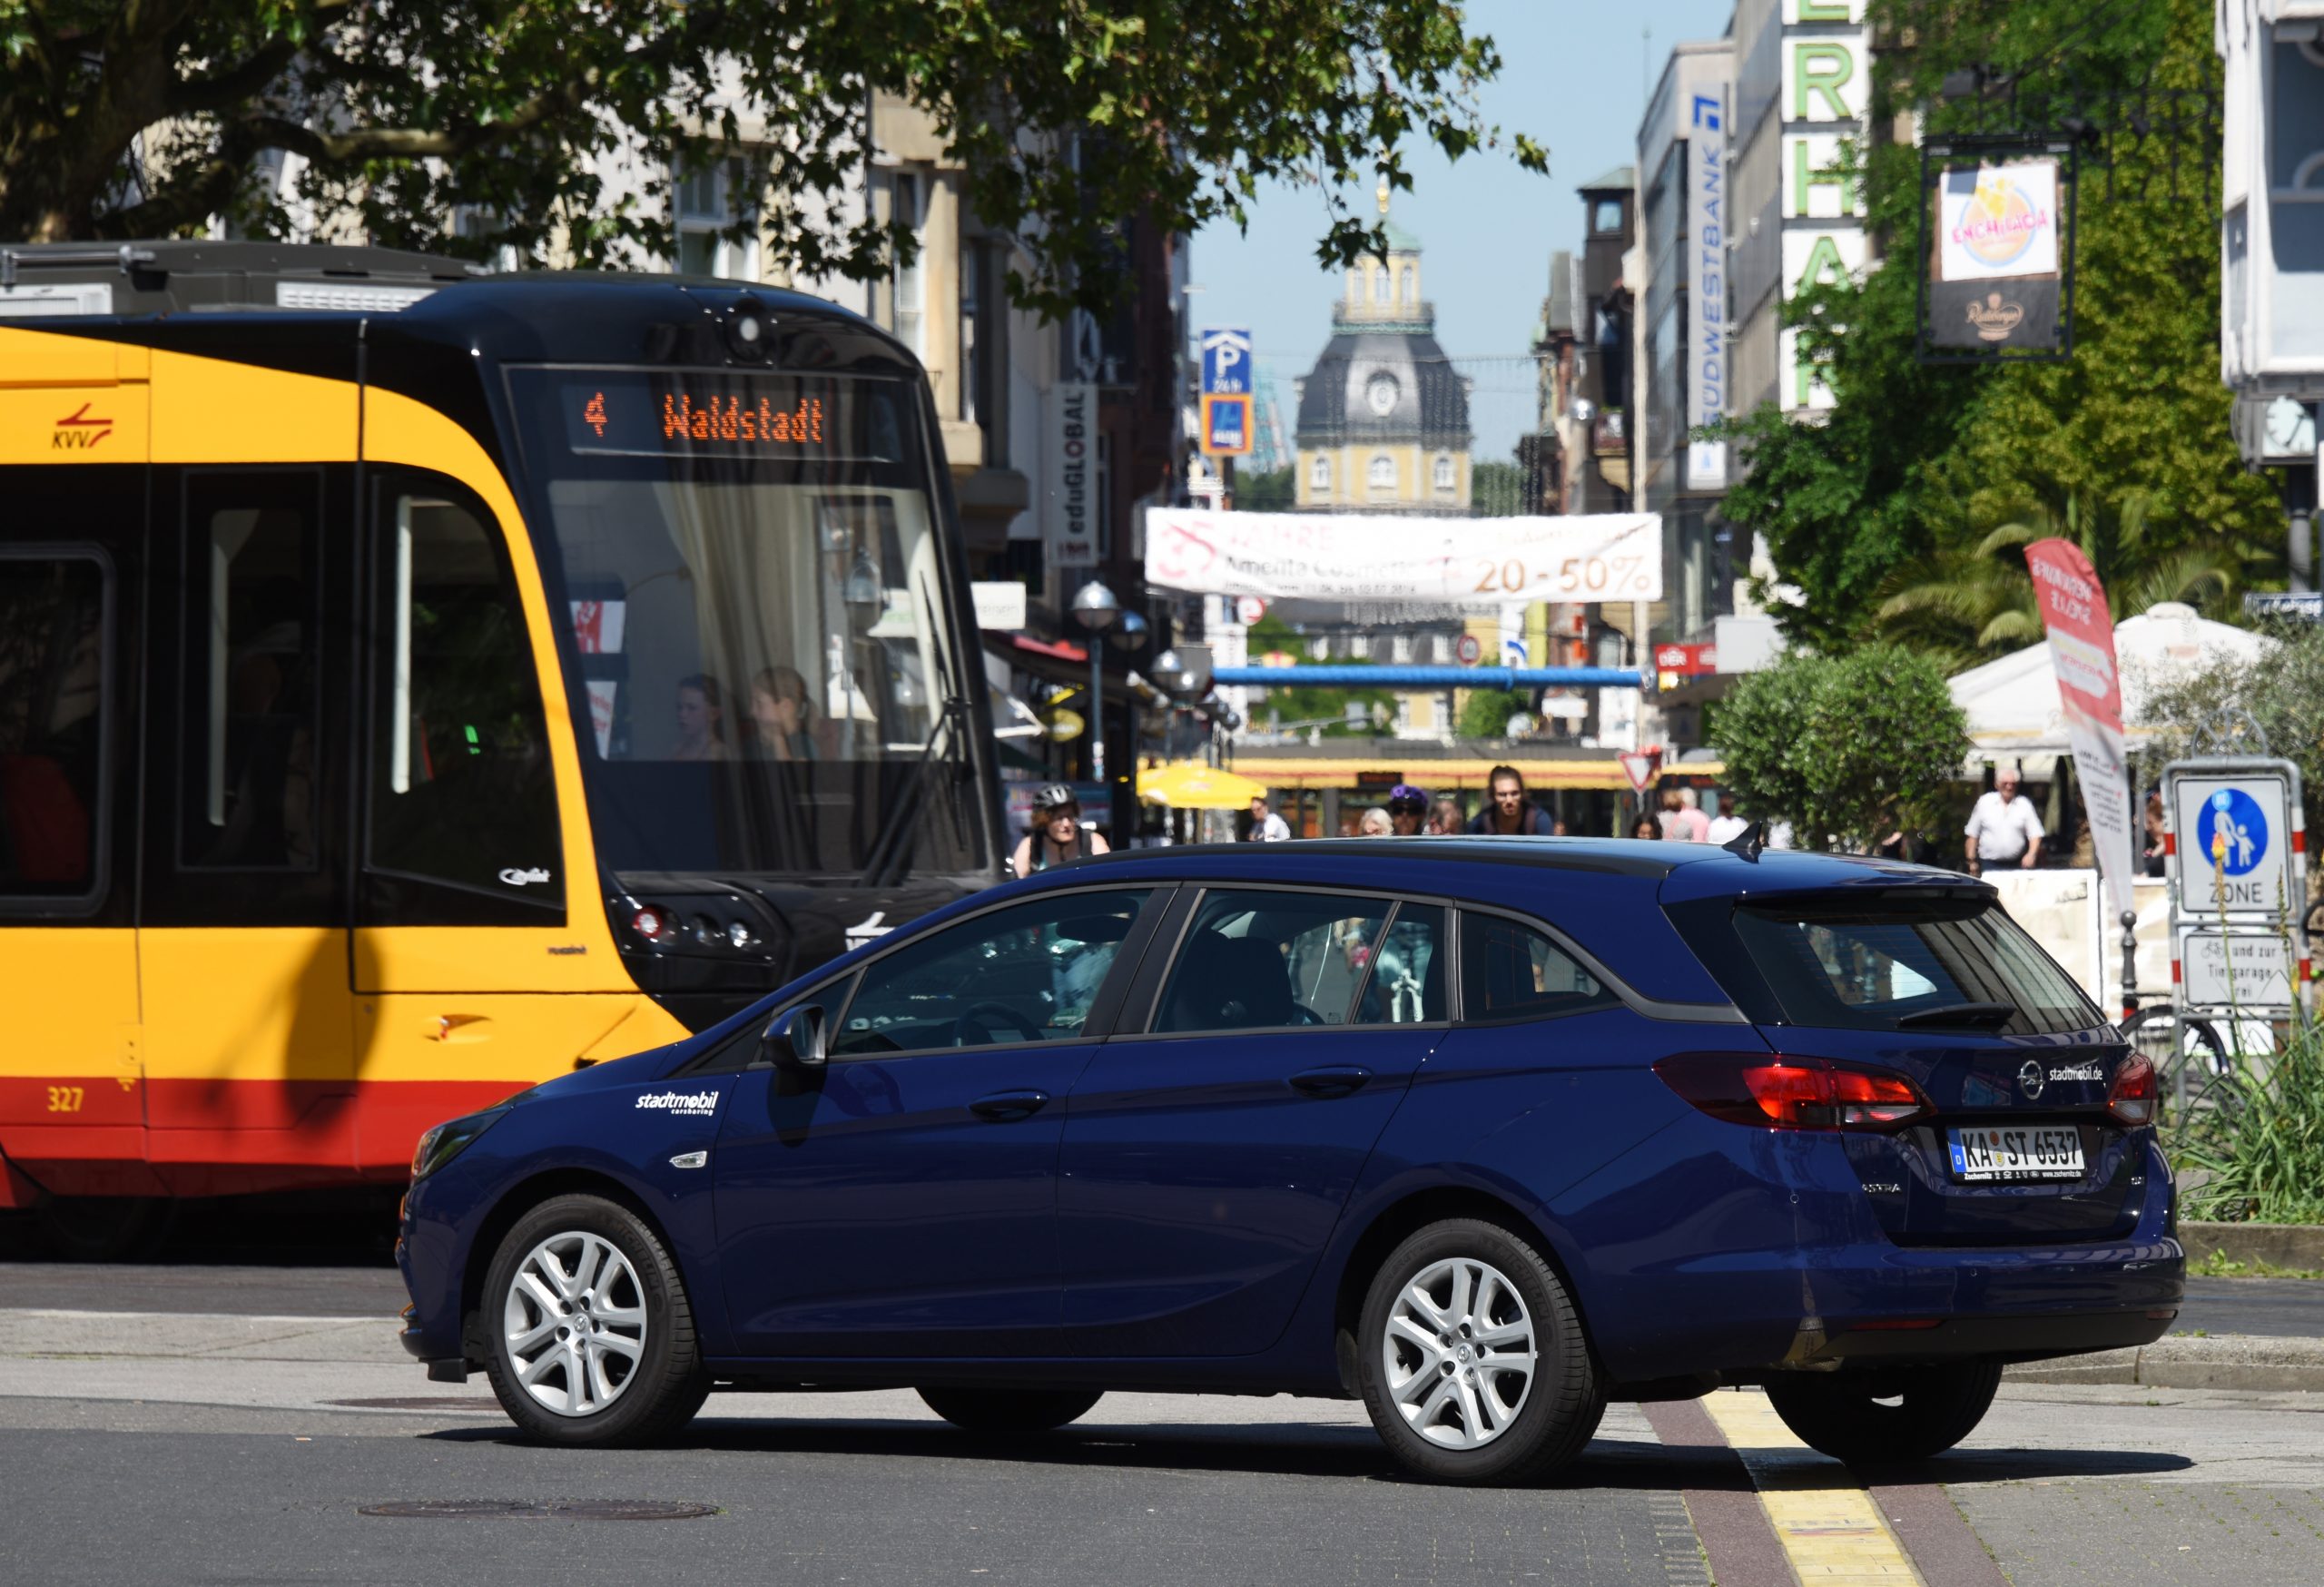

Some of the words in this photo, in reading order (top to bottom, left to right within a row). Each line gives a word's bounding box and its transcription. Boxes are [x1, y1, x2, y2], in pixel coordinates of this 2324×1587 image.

[1953, 209, 2049, 244] ENCHILADA
[1216, 344, 1241, 377] P
[583, 391, 608, 438] 4
[663, 392, 822, 444] Waldstadt
[51, 429, 90, 449] KVV
[1063, 392, 1086, 534] eduGLOBAL
[1472, 557, 1526, 594] 20
[1559, 555, 1651, 594] 50%
[1658, 648, 1688, 667] DER
[2209, 882, 2263, 903] ZONE
[2232, 946, 2253, 957] und
[2259, 946, 2277, 957] zur
[2208, 964, 2271, 980] Tiegarage
[2231, 983, 2252, 997] rei
[2049, 1066, 2103, 1081] stadtmobil.de
[47, 1086, 84, 1112] 327
[635, 1090, 719, 1109] stadtmobil
[670, 1108, 714, 1117] carsharing
[1955, 1156, 1962, 1166] D
[1961, 1132, 1993, 1168] KA
[2003, 1131, 2030, 1167] ST
[2034, 1130, 2077, 1166] 6537
[1861, 1183, 1903, 1193] ASTRA
[611, 1220, 662, 1290] MICHELIN
[1494, 1244, 1551, 1320] MICHELIN
